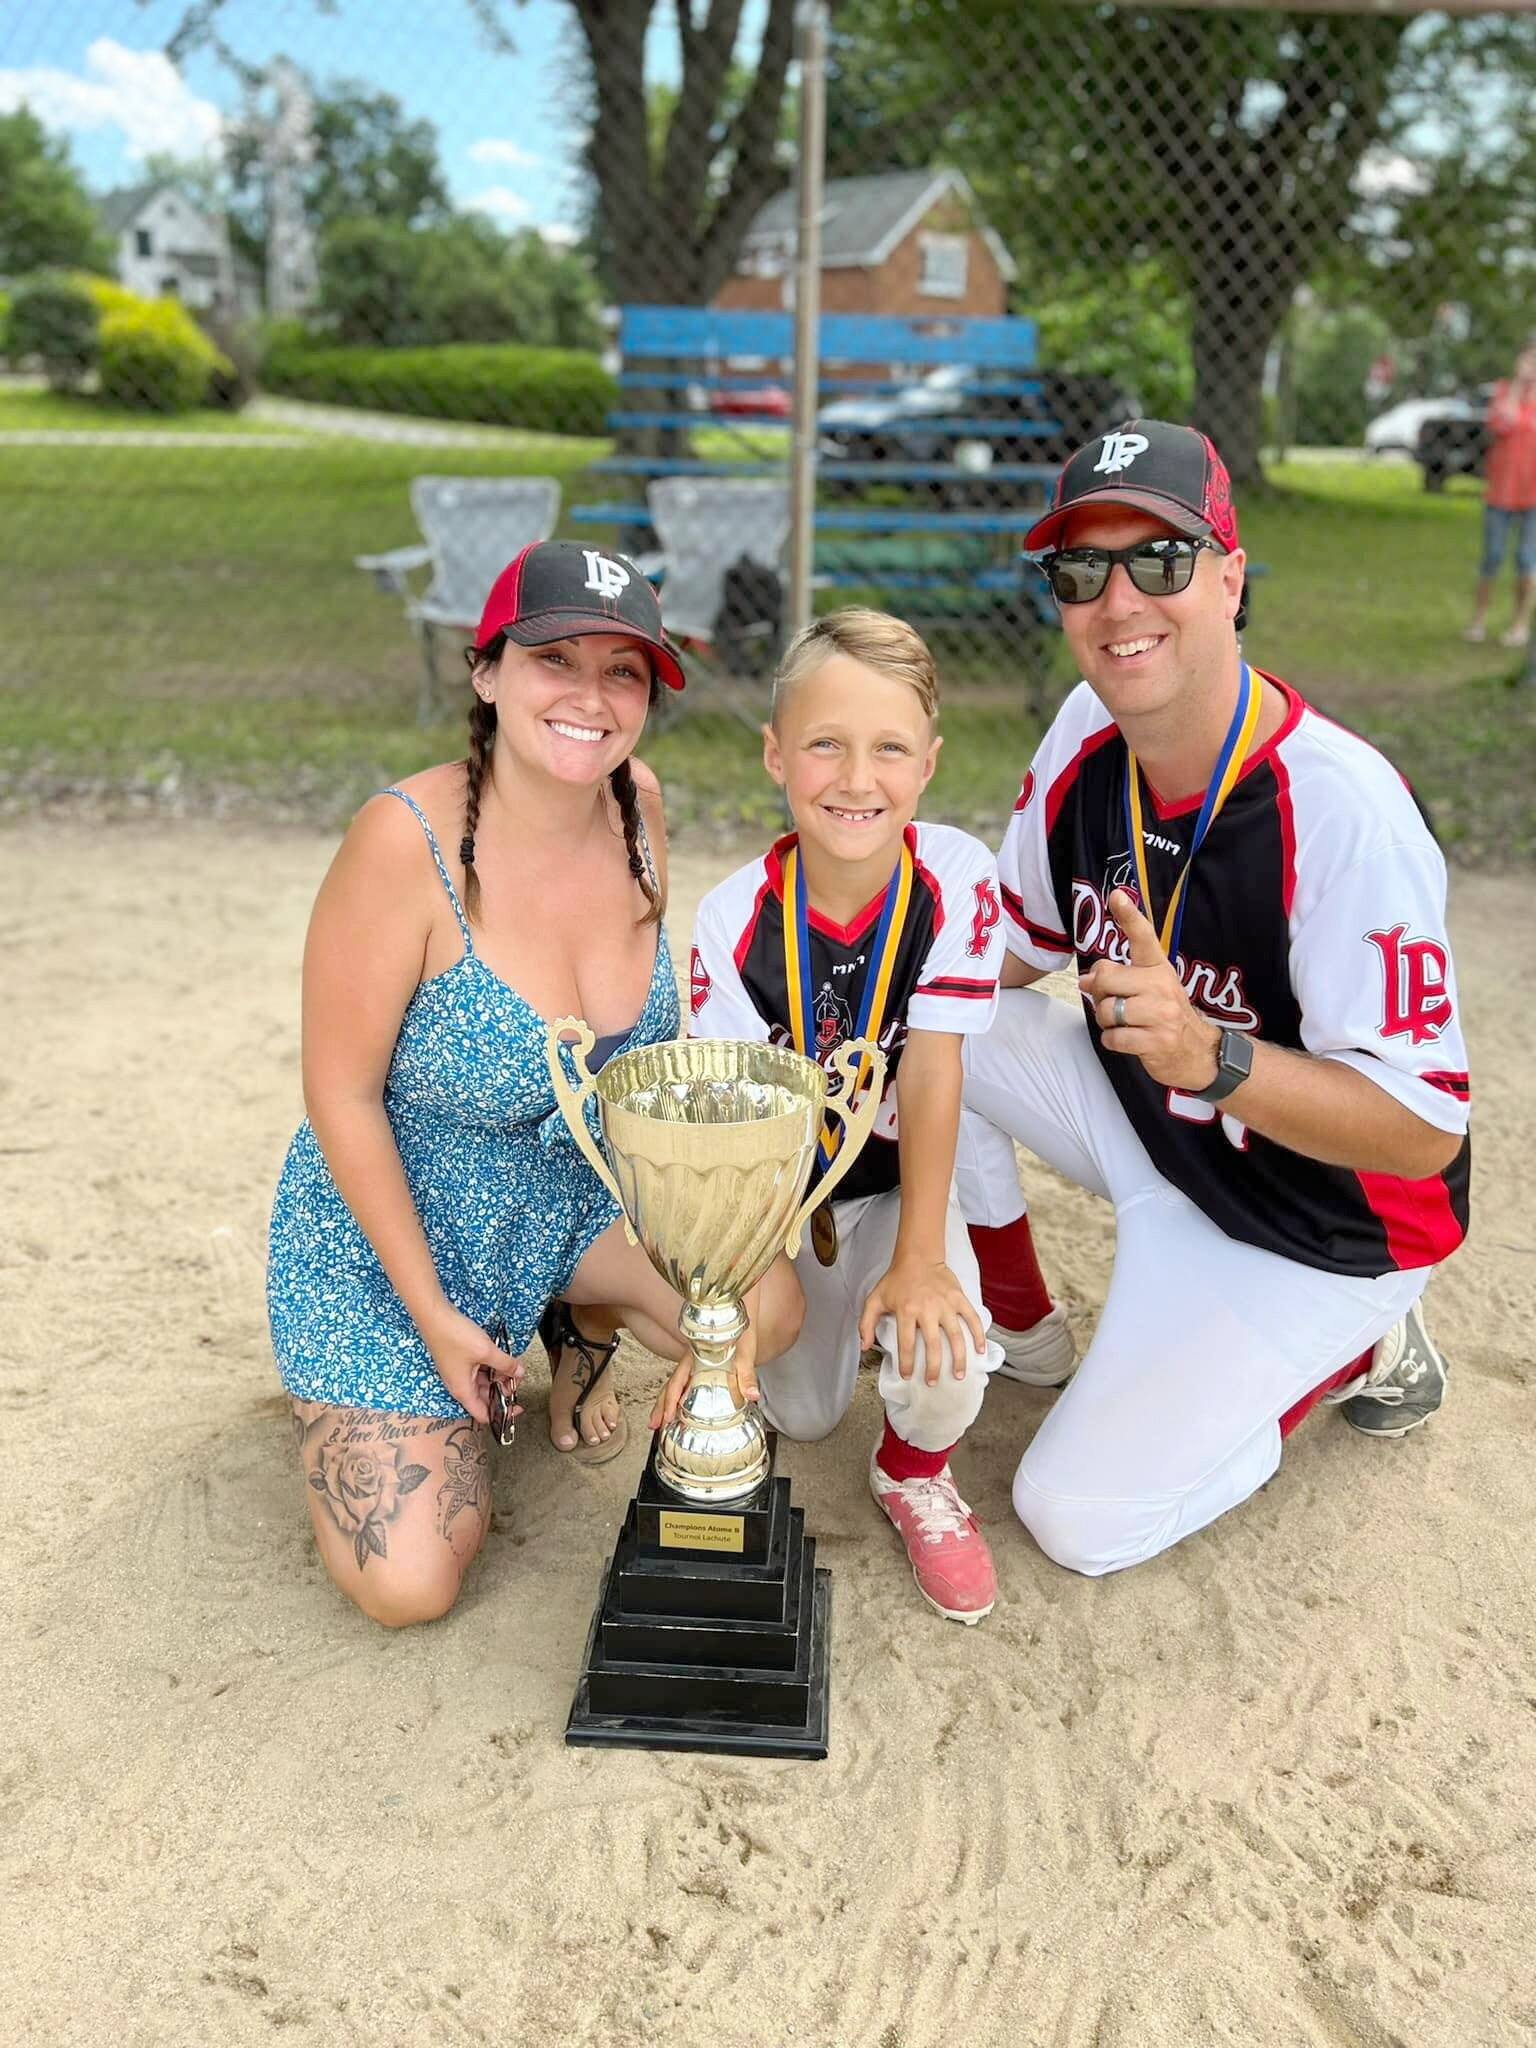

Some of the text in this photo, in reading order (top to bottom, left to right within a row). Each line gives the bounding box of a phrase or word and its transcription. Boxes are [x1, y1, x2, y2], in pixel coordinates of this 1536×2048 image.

[1141, 830, 1181, 856] MNM
[1362, 922, 1454, 1048] LP
[328, 1427, 341, 1443] &
[341, 1426, 373, 1444] Love
[374, 1421, 419, 1441] Never
[664, 1522, 707, 1532] Champions
[707, 1525, 733, 1533] Atome
[702, 1534, 731, 1543] Lachute
